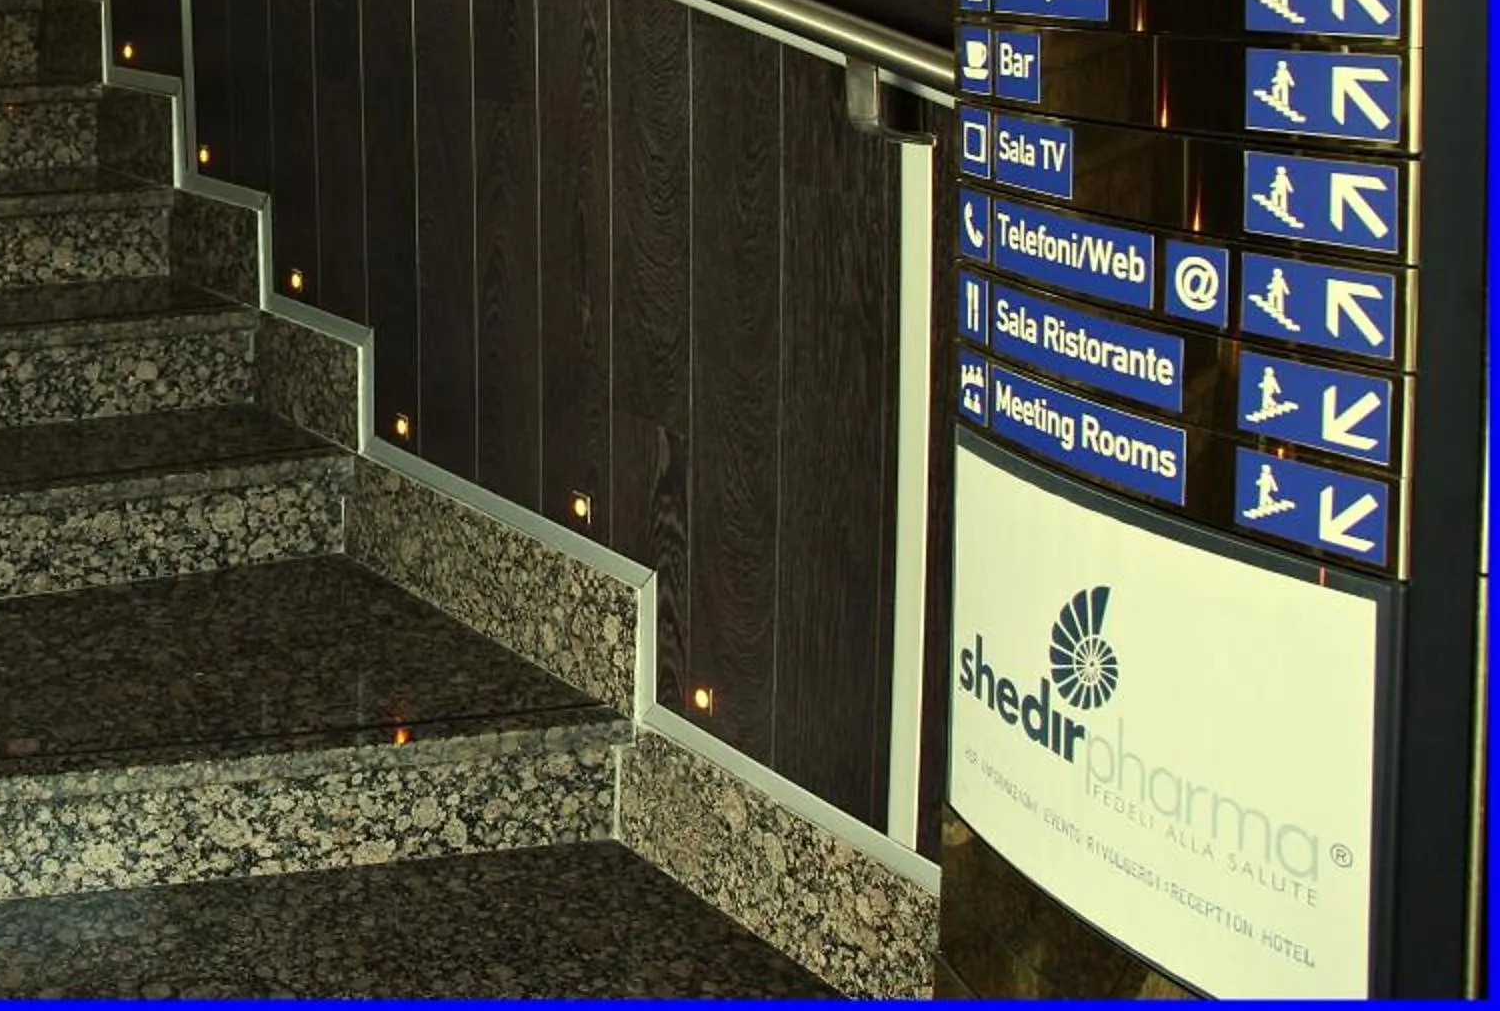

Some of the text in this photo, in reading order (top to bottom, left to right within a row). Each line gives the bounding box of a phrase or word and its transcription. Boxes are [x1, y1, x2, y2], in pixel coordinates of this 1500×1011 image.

[1001, 43, 1034, 78] Bar
[999, 132, 1067, 173] Sala TV
[997, 212, 1146, 284] Telefoni/Web
[1175, 255, 1219, 312] @
[996, 299, 1175, 387] Sala Ristorante
[995, 380, 1178, 478] Meeting Rooms
[1093, 783, 1155, 830] FEDELI
[1165, 824, 1215, 862] ALLA
[1228, 853, 1318, 908] SALUTE
[1262, 929, 1316, 969] HOTEL
